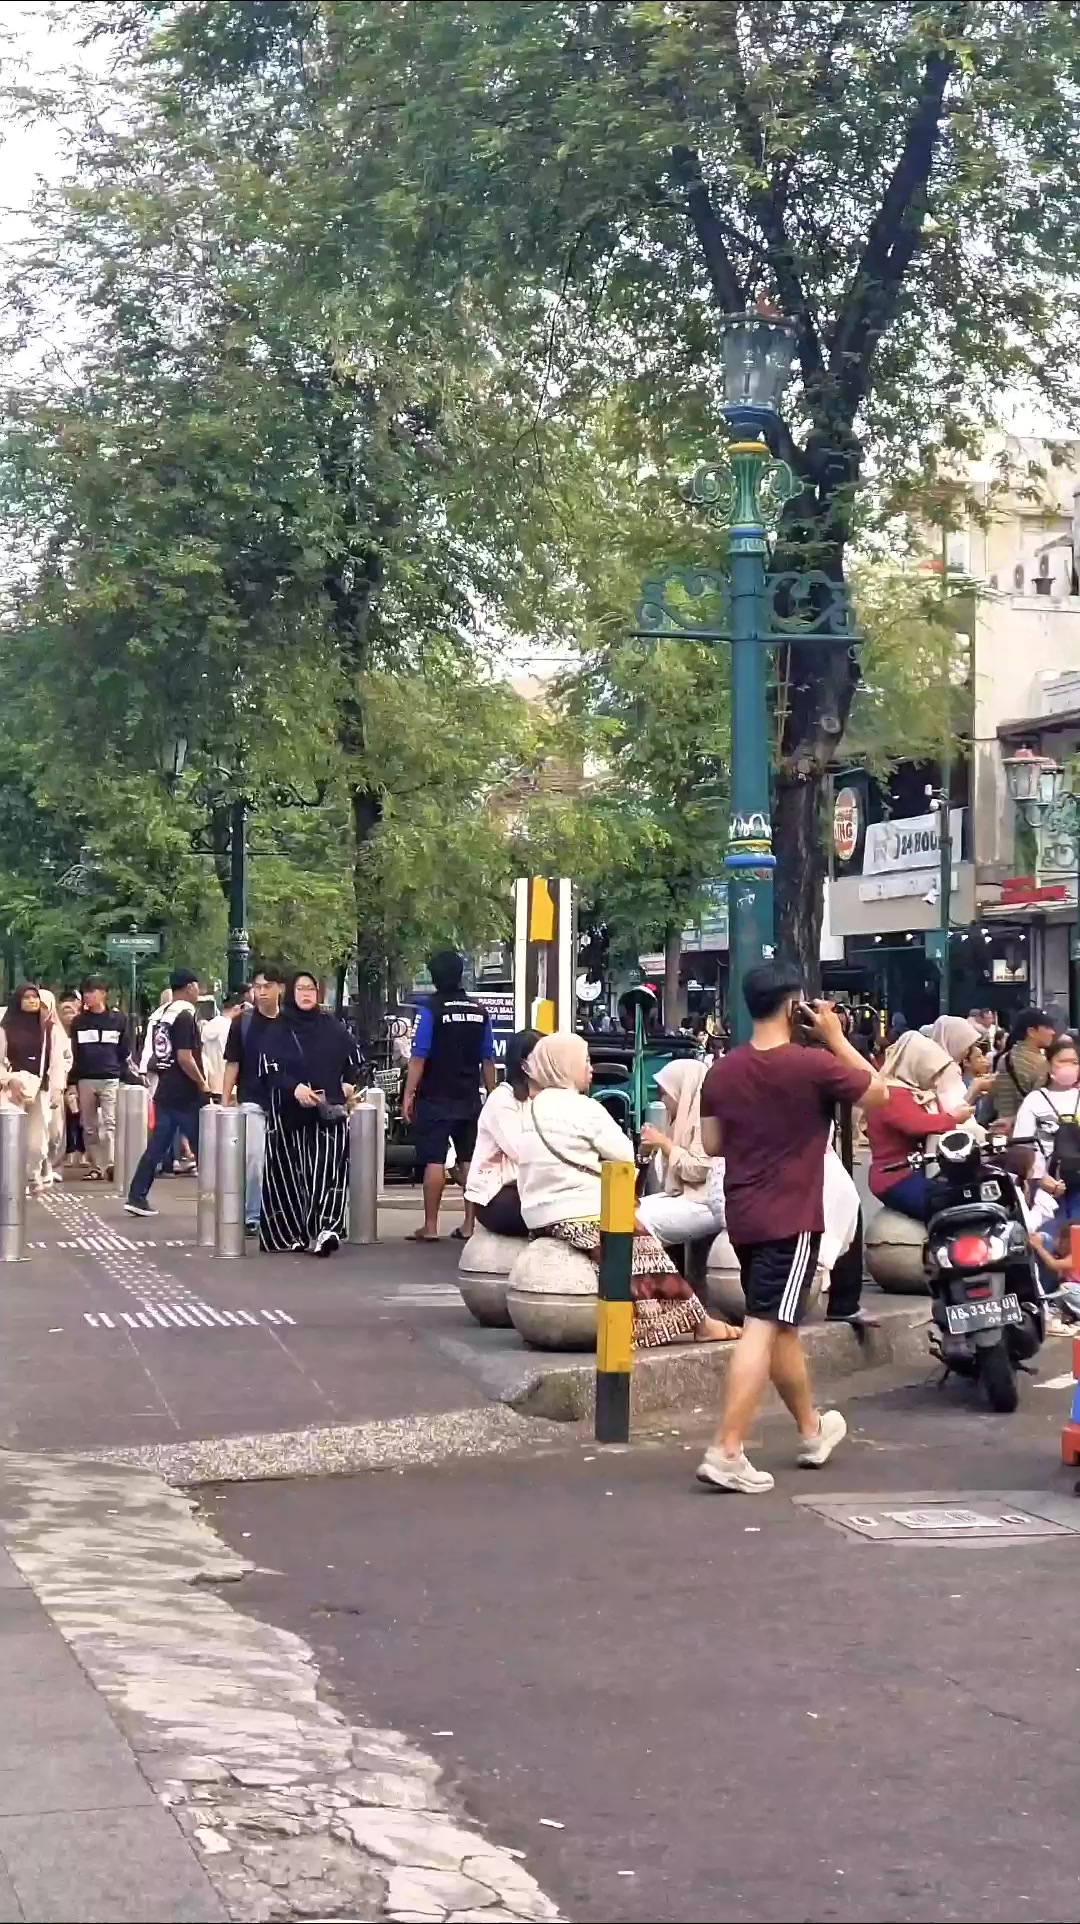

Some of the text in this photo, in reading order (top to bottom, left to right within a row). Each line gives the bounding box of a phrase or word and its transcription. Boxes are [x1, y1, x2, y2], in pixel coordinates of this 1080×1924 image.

[914, 830, 941, 852] HOU
[478, 998, 504, 1006] PARKIR
[1002, 1297, 1017, 1309] UV
